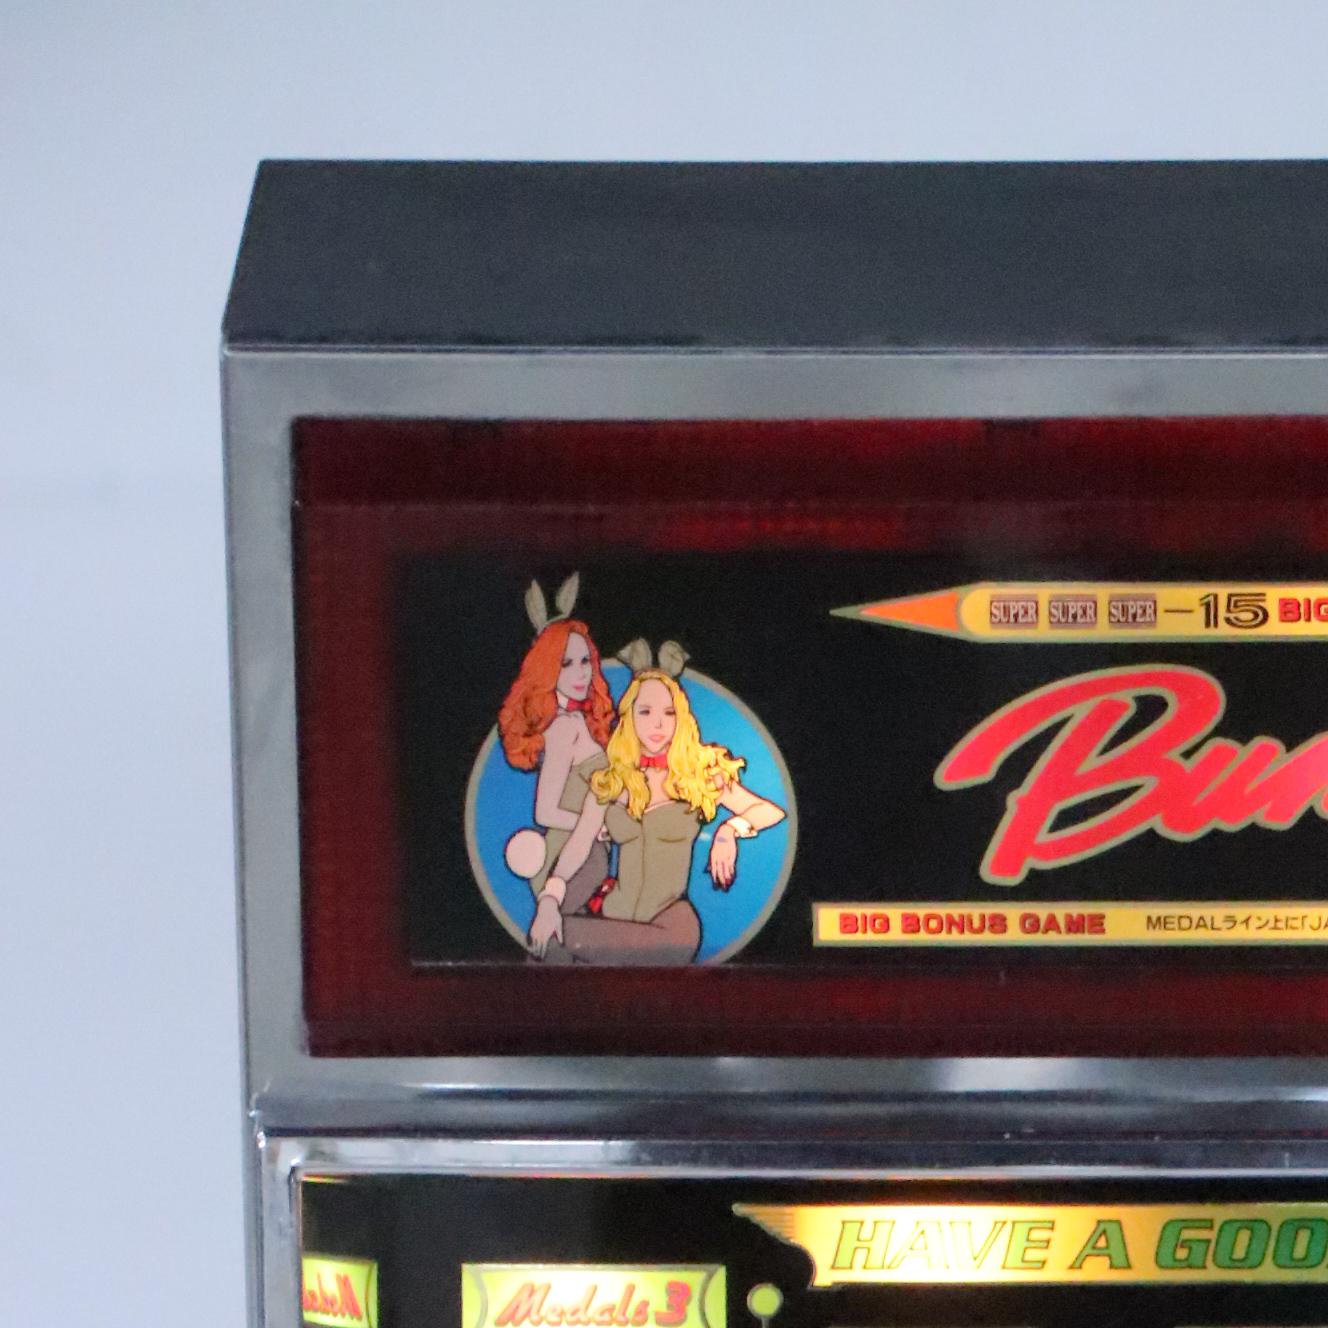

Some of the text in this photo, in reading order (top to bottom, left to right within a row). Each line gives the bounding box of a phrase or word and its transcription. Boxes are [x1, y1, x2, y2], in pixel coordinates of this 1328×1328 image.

[990, 600, 1037, 624] SUPER
[1049, 600, 1096, 624] SUPER
[1109, 600, 1156, 624] SUPER
[1199, 592, 1269, 629] 15
[839, 912, 1106, 935] BIG BONUS GAME
[831, 1219, 1055, 1270] HAVE
[1069, 1219, 1132, 1270] A
[493, 1280, 694, 1328] Medals 3
